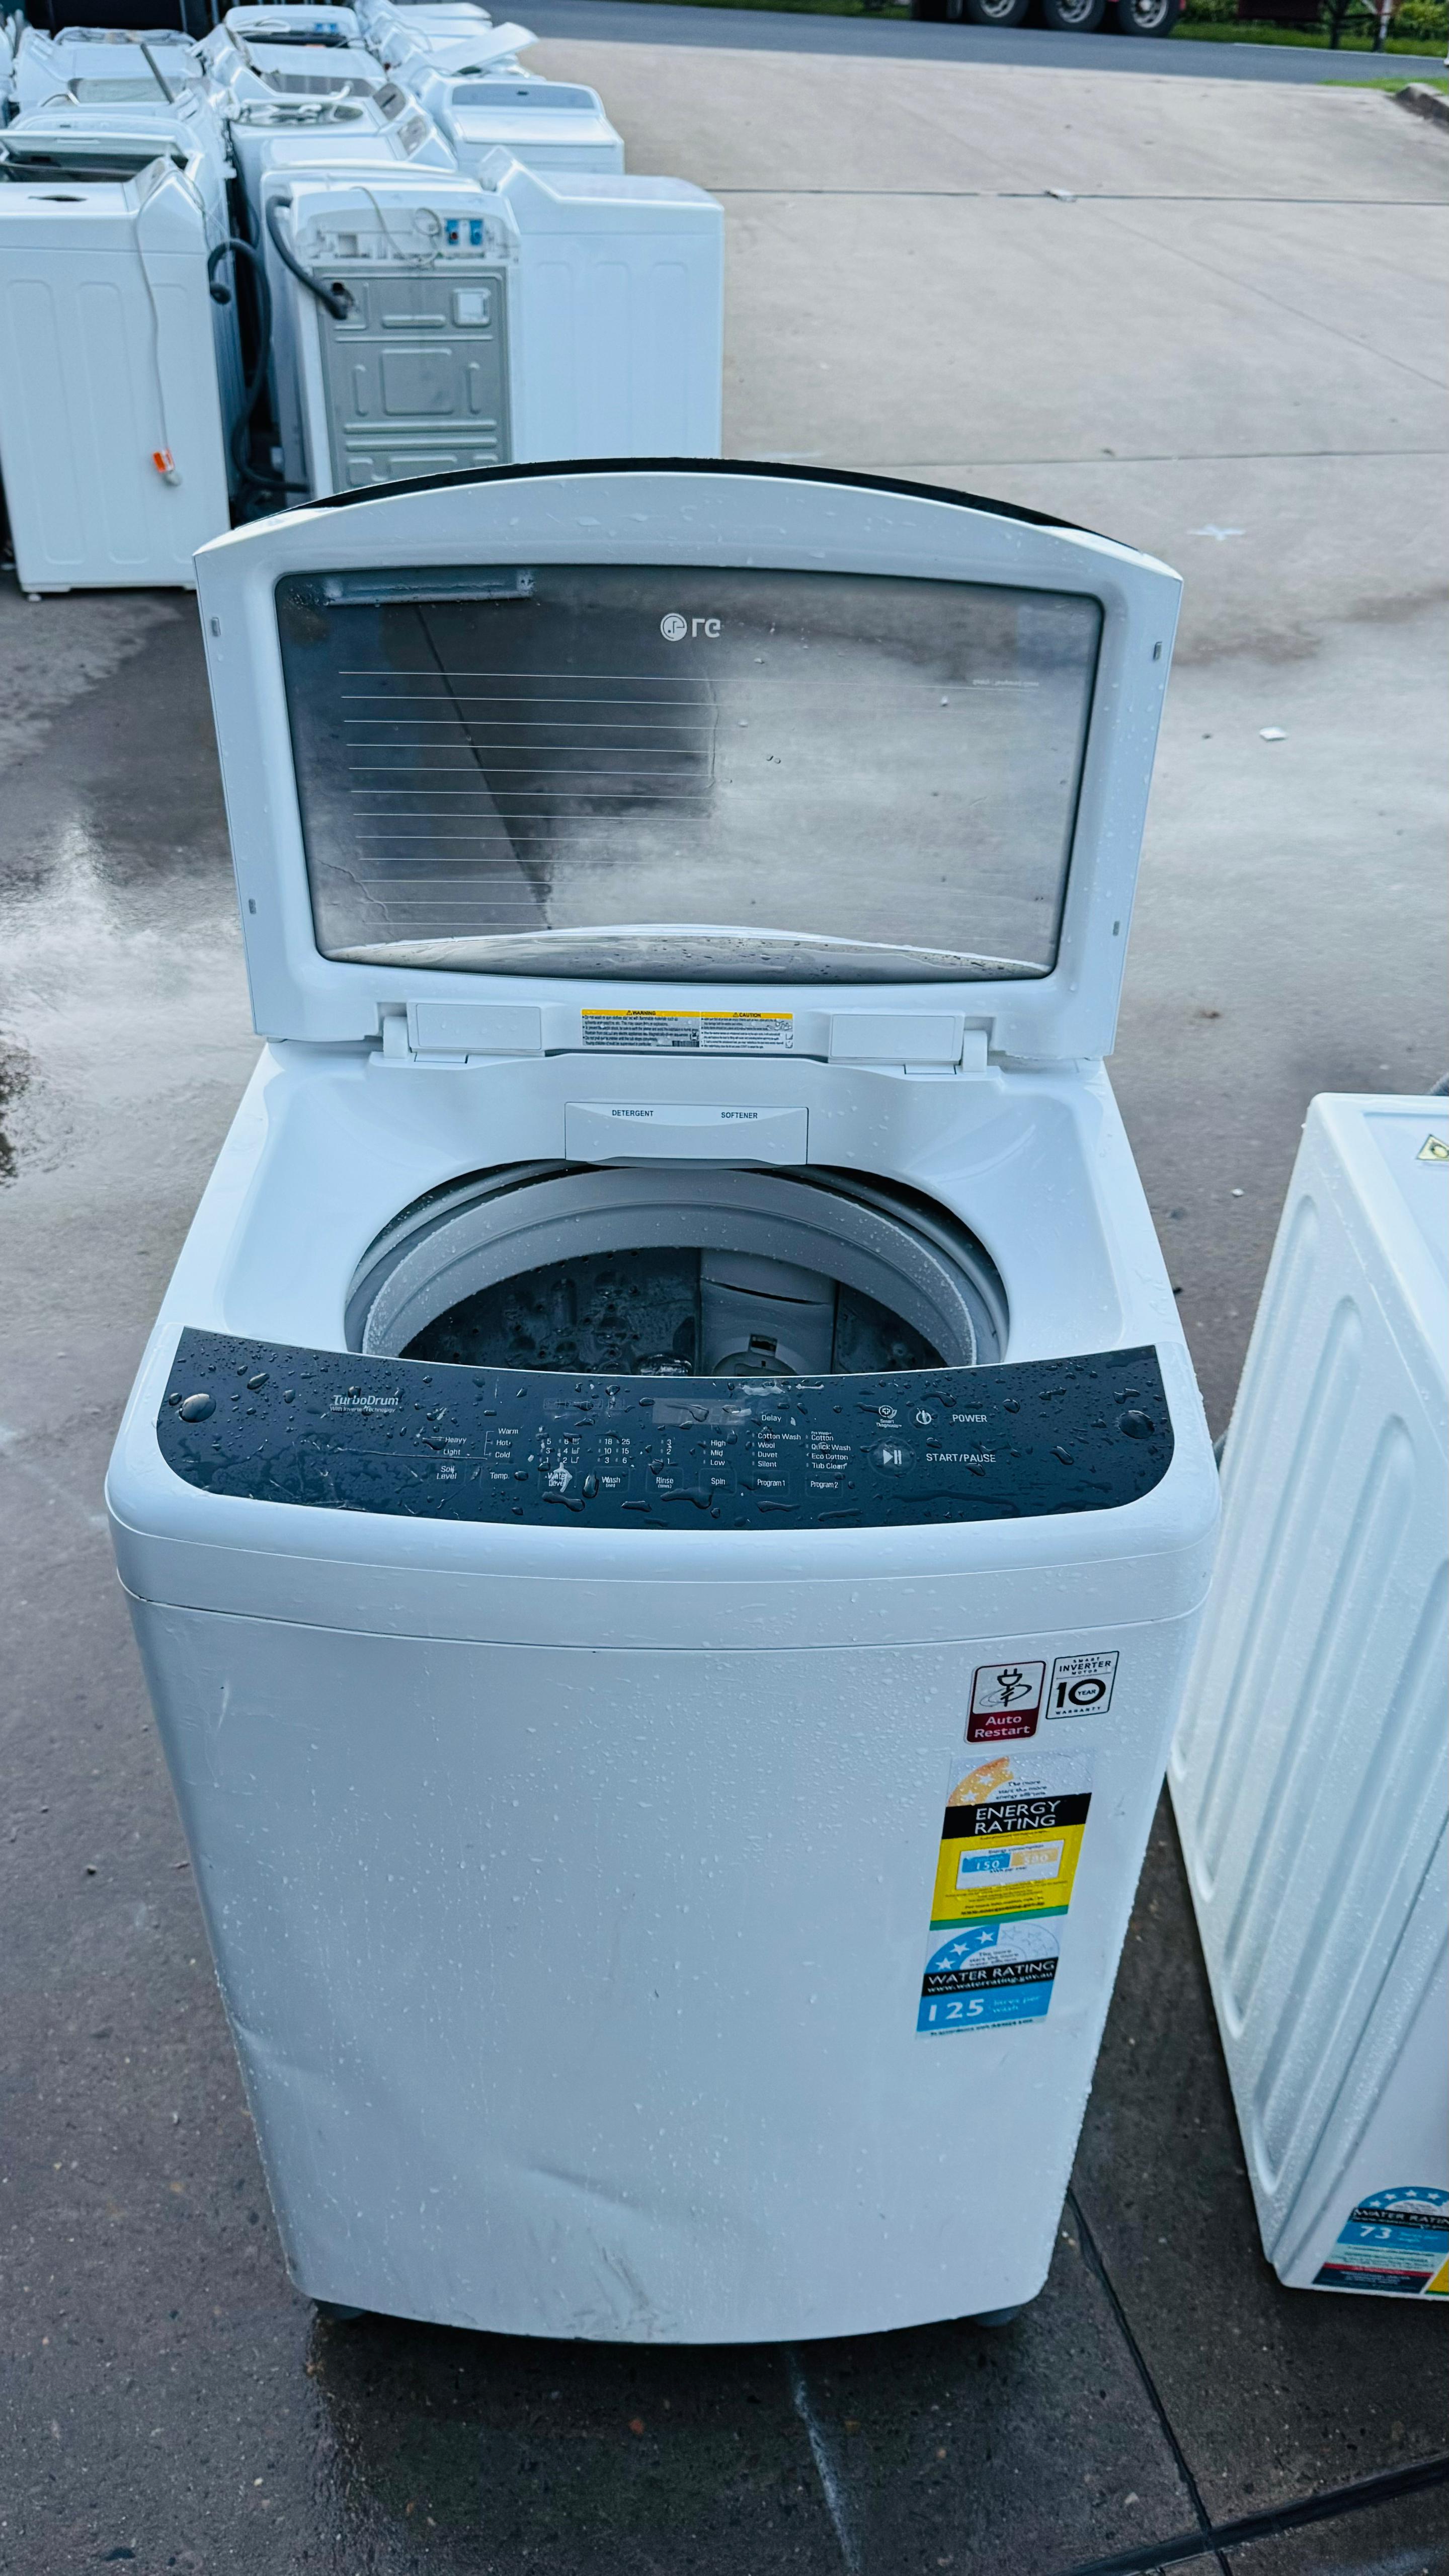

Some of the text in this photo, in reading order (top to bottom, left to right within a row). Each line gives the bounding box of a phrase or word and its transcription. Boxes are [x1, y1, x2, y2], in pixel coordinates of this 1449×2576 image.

[333, 1395, 399, 1405] TurboDrum
[761, 1414, 782, 1422] Delay
[952, 1414, 988, 1423] POWER
[758, 1432, 780, 1440] Cotton
[443, 1448, 461, 1457] Light
[926, 1453, 997, 1463] START/PAUSE
[440, 1465, 455, 1473] Soil
[490, 1472, 510, 1480] Temp.
[602, 1476, 620, 1484] Wash
[710, 1477, 726, 1485] Spin
[757, 1479, 782, 1487] Program
[811, 1481, 834, 1489] Program
[1059, 1660, 1112, 1672] INVERTER
[1057, 1678, 1106, 1709] 10
[1078, 1688, 1096, 1697] YEAR
[1055, 1706, 1101, 1716] WARRANTY
[985, 1715, 1022, 1726] Auto
[974, 1725, 1031, 1738] Restart
[976, 1800, 1061, 1820] ENERGY
[974, 1815, 1056, 1834] RATING
[976, 1860, 1001, 1870] 150
[928, 1970, 988, 1985] WATER
[993, 1960, 1056, 1978] RATING
[928, 1998, 985, 2022] 125
[1353, 2208, 1404, 2220] WATER
[1360, 2225, 1393, 2239] 73
